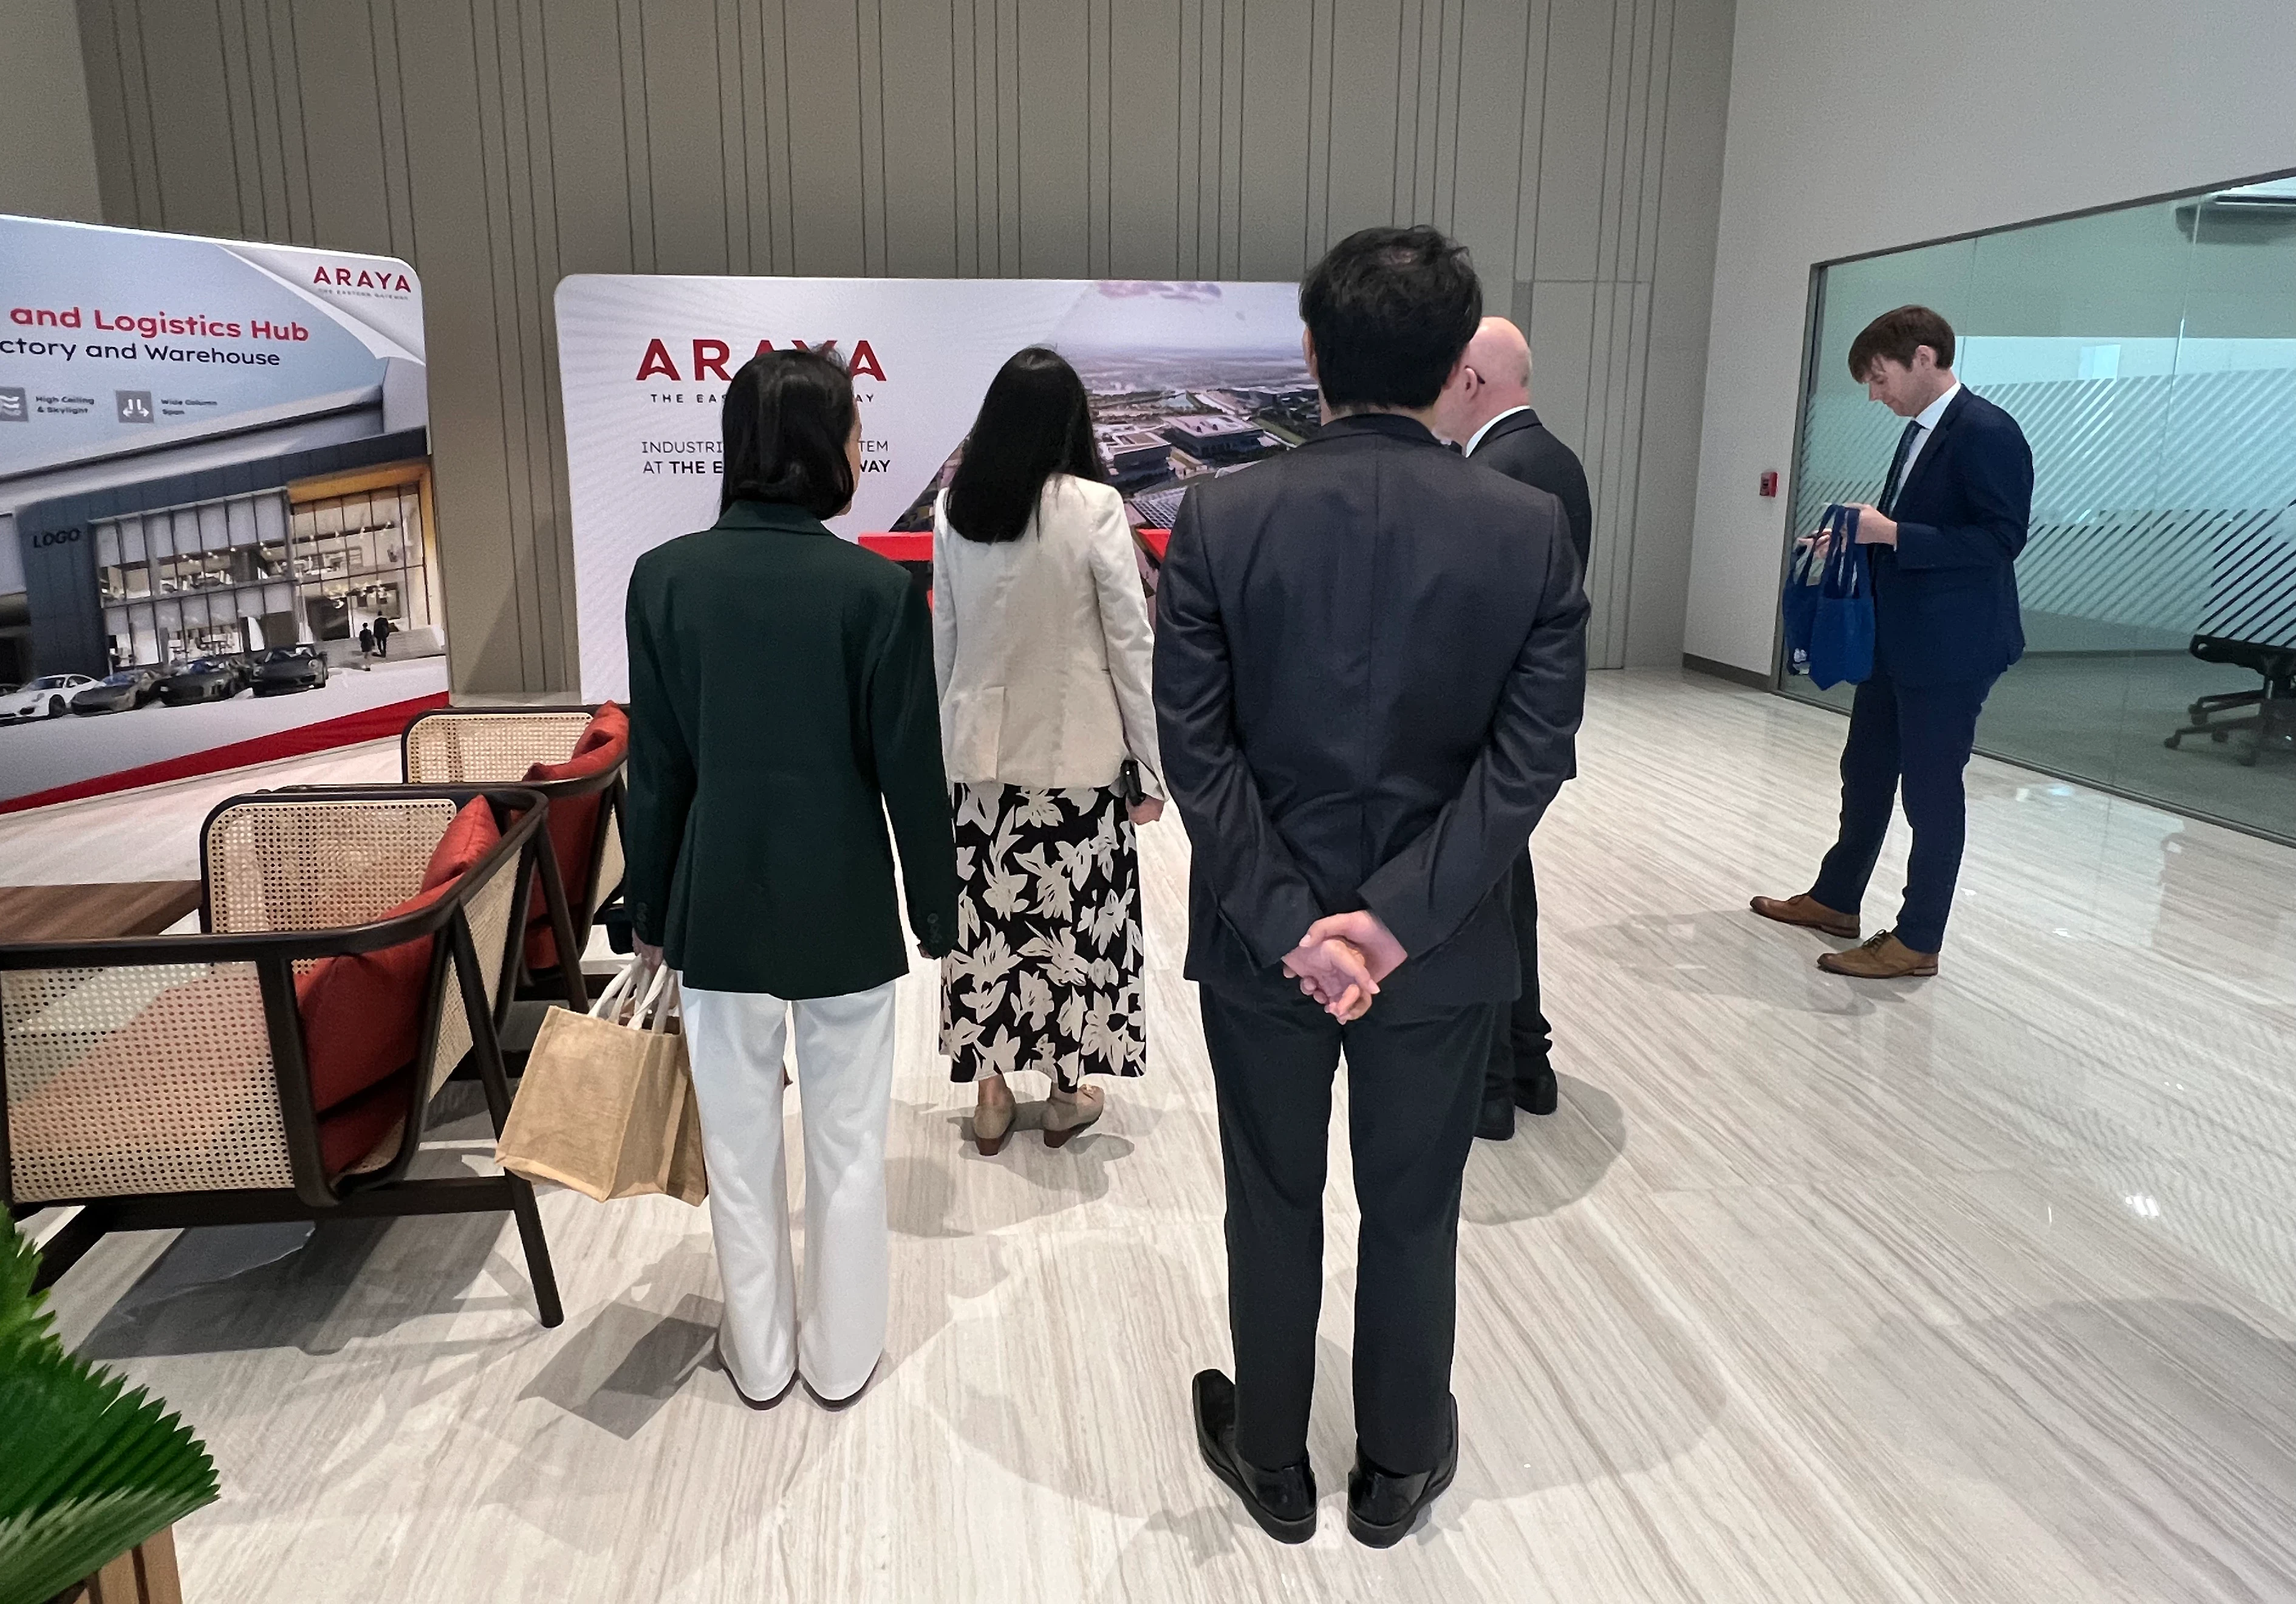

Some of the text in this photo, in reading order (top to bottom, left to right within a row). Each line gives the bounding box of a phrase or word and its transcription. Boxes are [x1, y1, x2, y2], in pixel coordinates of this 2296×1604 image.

[313, 266, 411, 293] ARAYA
[10, 306, 309, 341] and Logistics Hub
[86, 343, 137, 360] and
[144, 344, 281, 366] Warehouse
[650, 394, 684, 403] THE
[643, 461, 663, 475] AT
[668, 461, 706, 475] THE
[33, 527, 82, 548] LOGO
